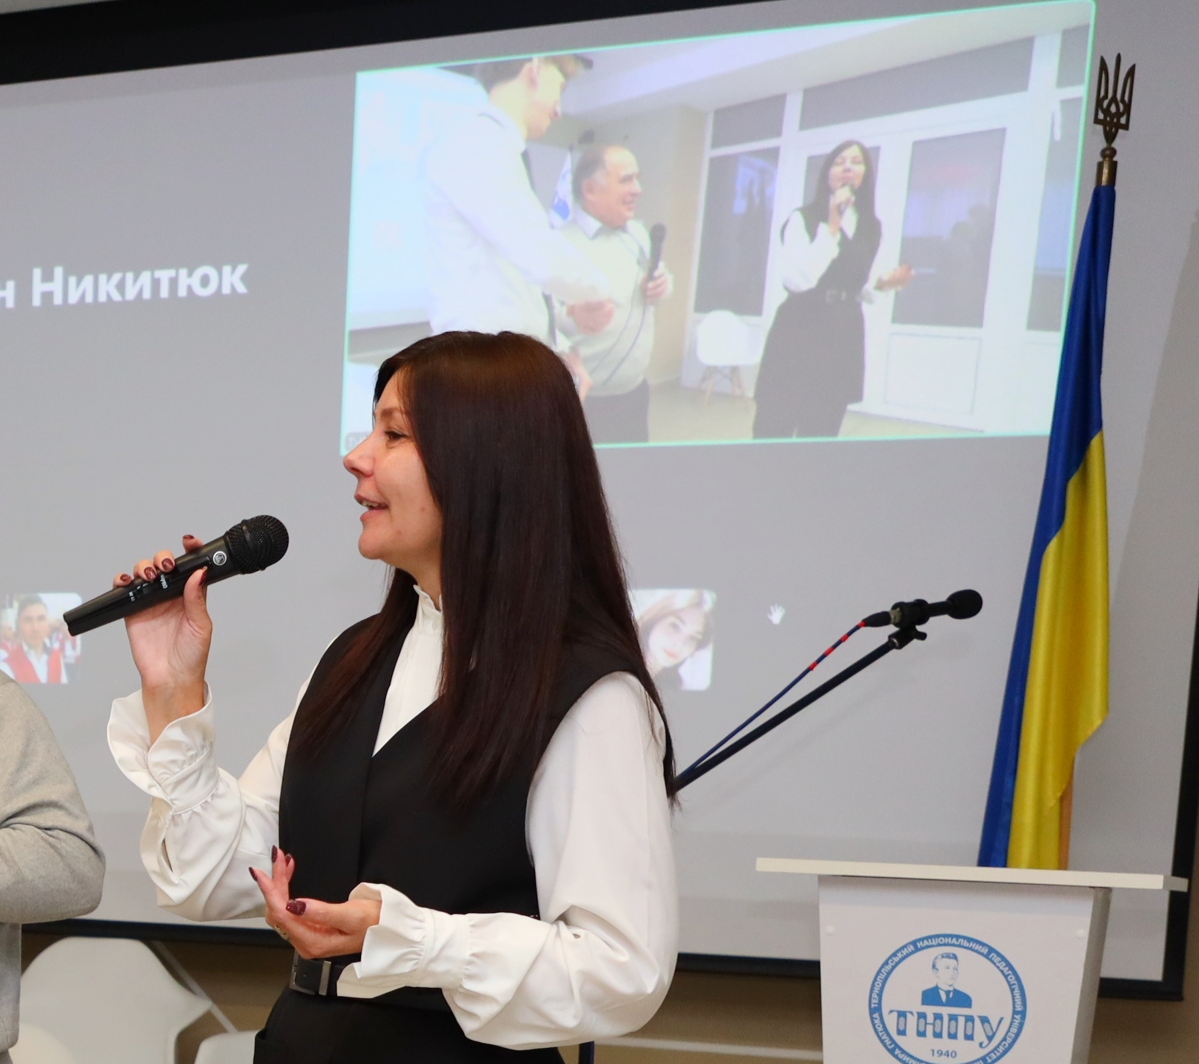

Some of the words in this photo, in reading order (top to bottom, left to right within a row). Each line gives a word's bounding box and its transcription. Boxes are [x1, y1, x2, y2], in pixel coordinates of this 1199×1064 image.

[31, 263, 248, 307] Никитюк
[916, 936, 989, 955] НАЦІОНАЛЬНИЙ
[888, 1009, 1004, 1049] ТНПУ
[930, 1048, 957, 1059] 1940
